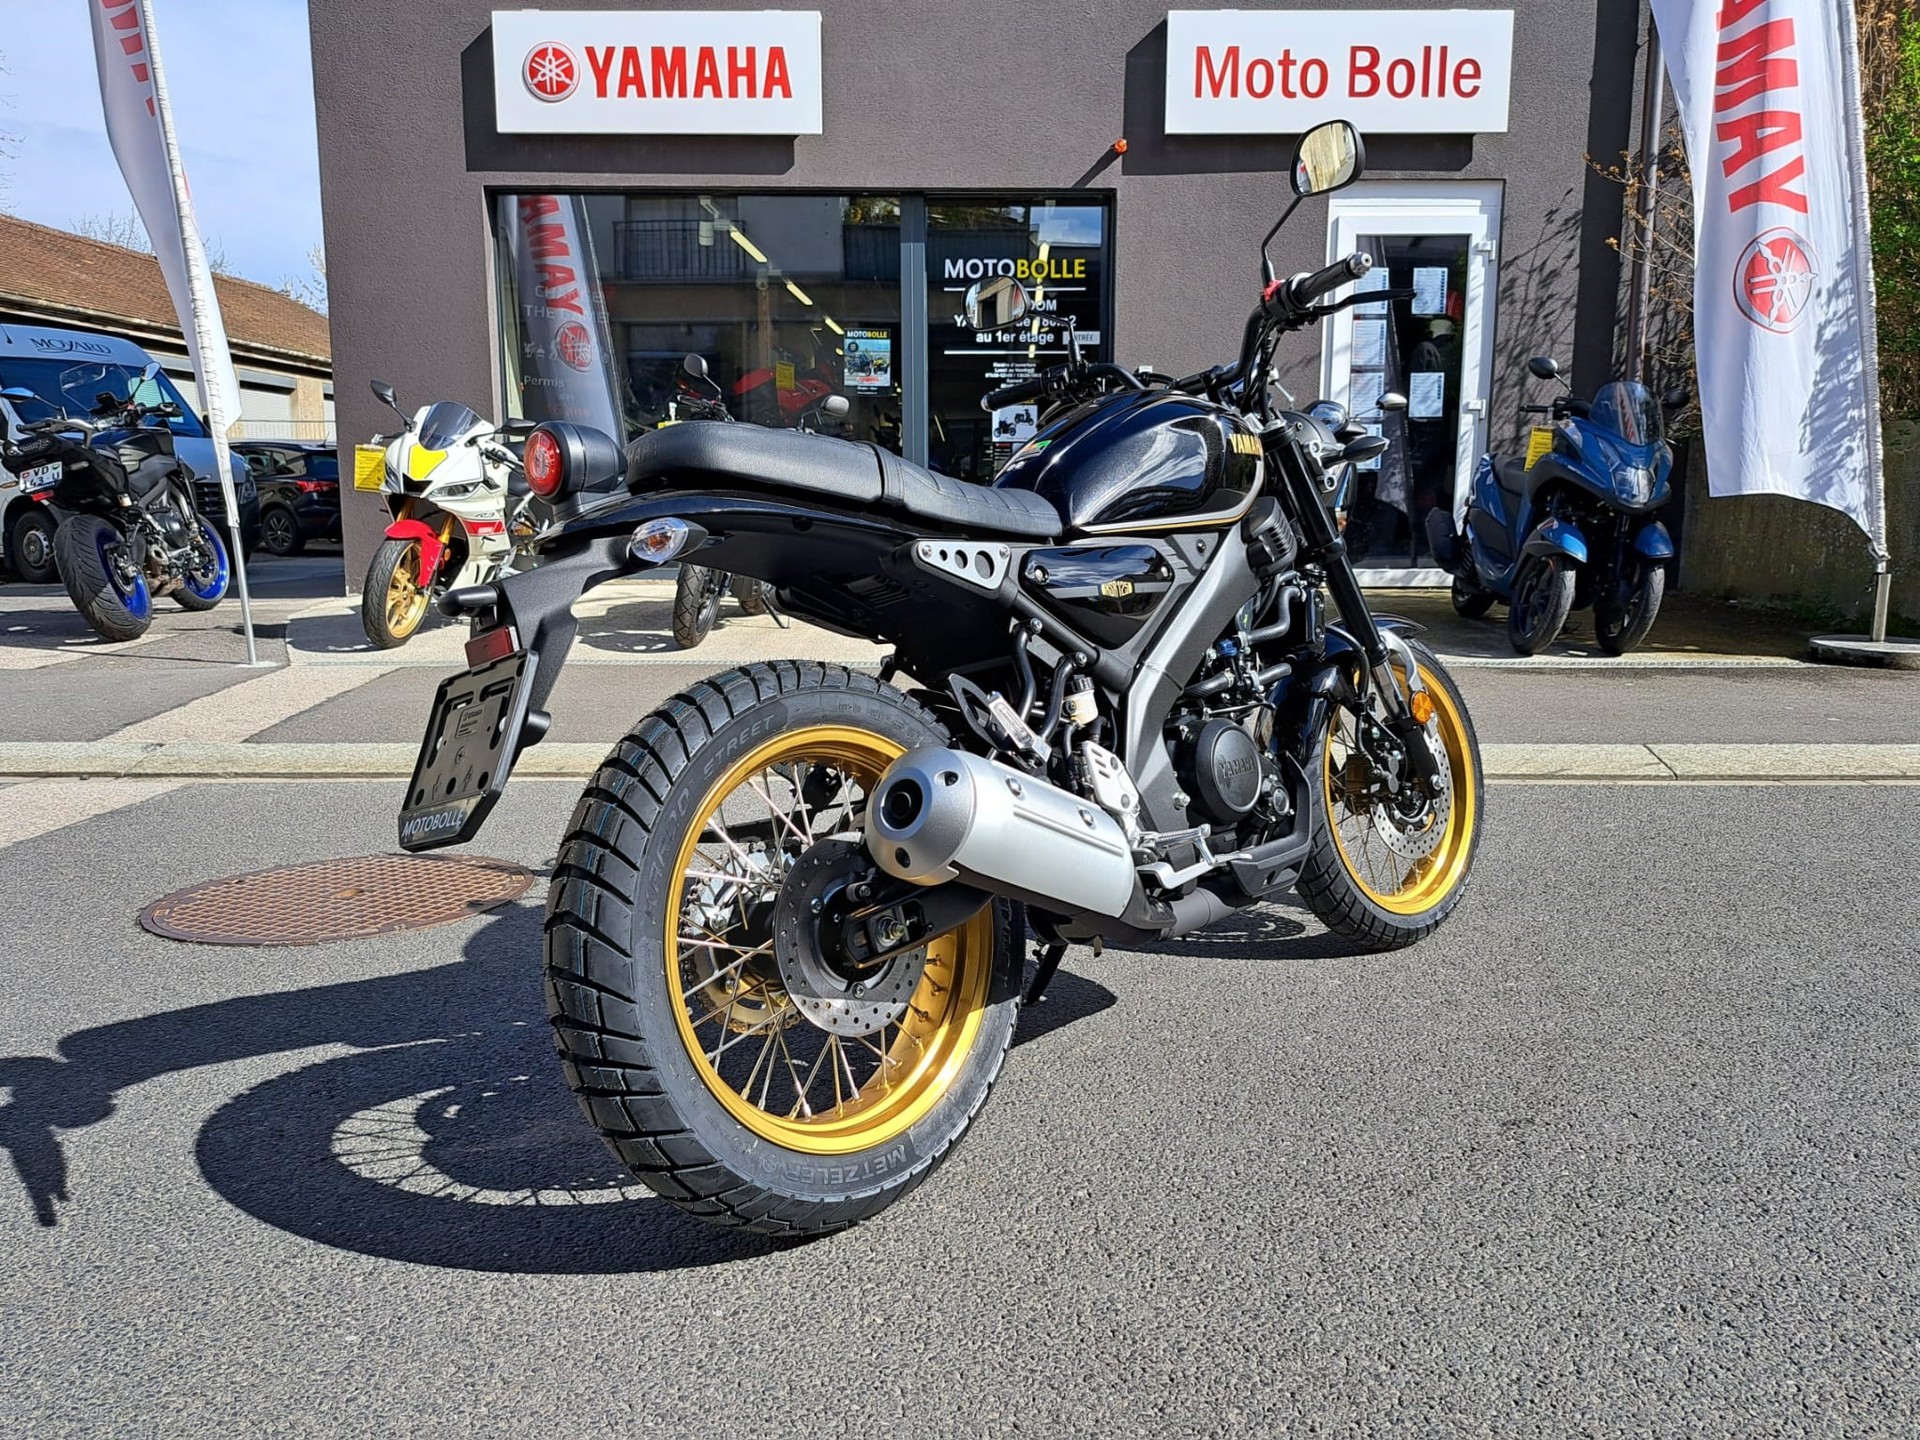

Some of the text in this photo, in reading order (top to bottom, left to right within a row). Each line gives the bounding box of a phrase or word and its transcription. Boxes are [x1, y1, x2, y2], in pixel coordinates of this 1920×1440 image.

[584, 46, 793, 98] YAMAHA
[1194, 45, 1481, 98] Moto Bolle
[945, 258, 1086, 279] MOTOBOLLE
[847, 330, 888, 338] MOTOBOLLE
[976, 330, 1054, 345] au 1er étage
[524, 375, 564, 388] Permis
[33, 466, 49, 477] VD
[401, 809, 465, 839] MOTOBOLLE
[783, 1144, 908, 1185] METZELER
